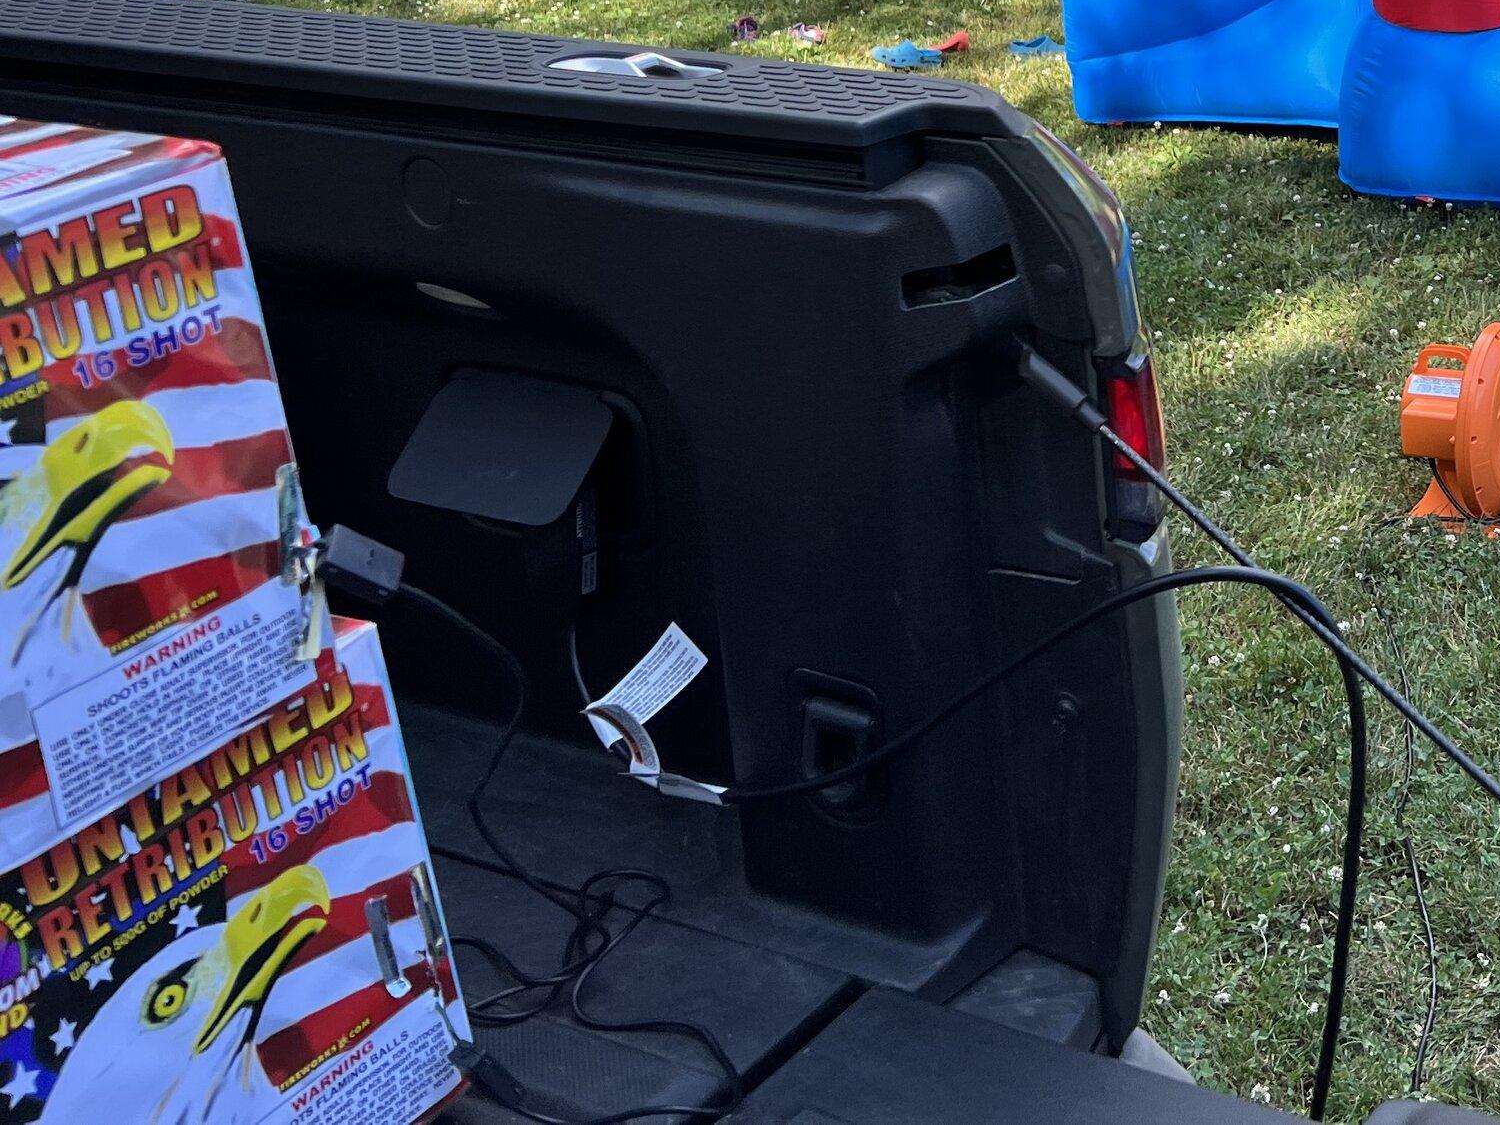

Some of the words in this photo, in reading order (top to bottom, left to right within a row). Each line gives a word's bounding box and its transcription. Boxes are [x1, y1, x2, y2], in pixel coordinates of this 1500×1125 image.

[72, 350, 117, 389] 16
[127, 304, 223, 369] SHOT
[86, 675, 148, 719] SHOOTS
[151, 638, 214, 682] FLAMING
[215, 612, 261, 646] BALLS
[122, 615, 221, 679] WARNING
[20, 665, 355, 905] UNTAMED
[249, 827, 287, 864] 16
[294, 763, 373, 834] SHOT
[37, 711, 370, 969] RETRIBUTION
[69, 961, 91, 982] UP
[91, 946, 112, 965] TO
[147, 905, 167, 925] OF
[169, 864, 229, 911] POWDER
[292, 1040, 374, 1111] WARNING
[316, 1061, 368, 1109] FLAMING
[370, 1030, 410, 1066] BALLS
